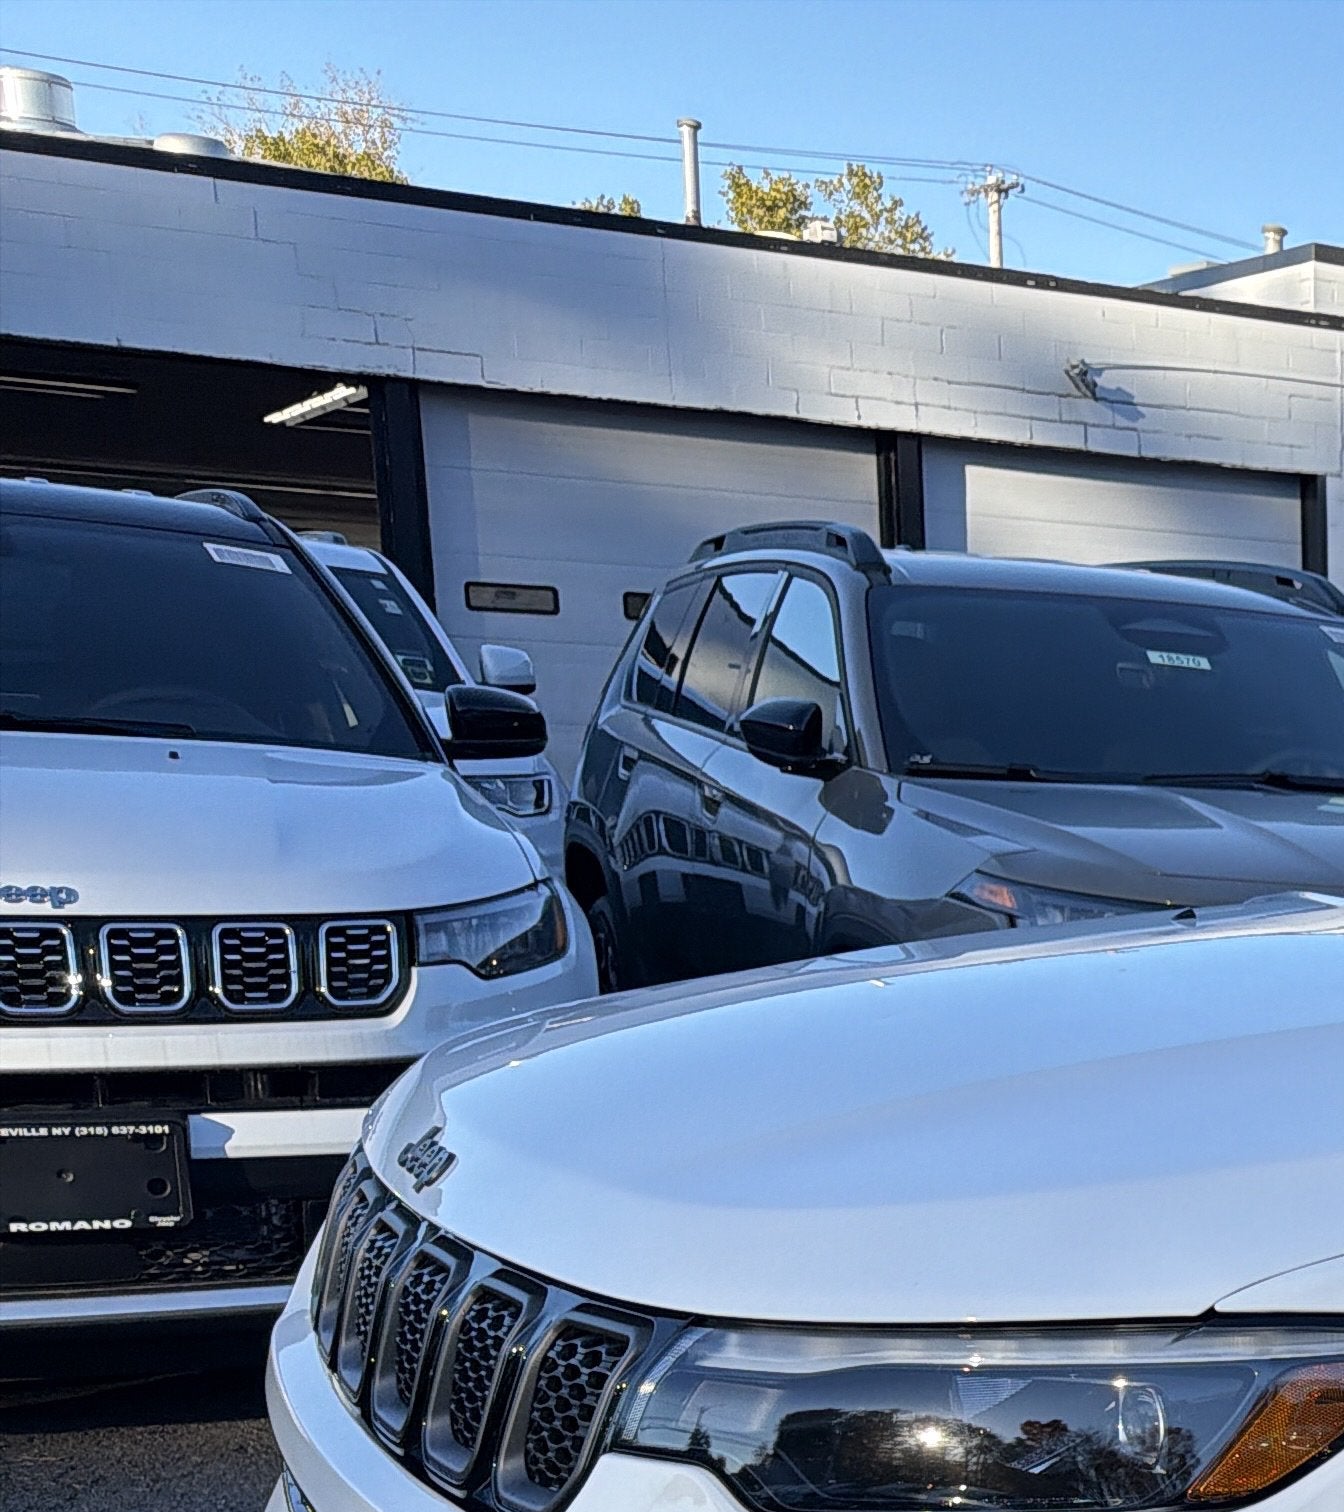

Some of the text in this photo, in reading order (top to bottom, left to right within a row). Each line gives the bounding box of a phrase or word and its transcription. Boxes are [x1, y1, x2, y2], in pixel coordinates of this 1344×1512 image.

[0, 885, 79, 909] eep
[0, 1127, 48, 1137] EVILLE
[52, 1126, 71, 1136] NY
[9, 1219, 133, 1233] ROMANO
